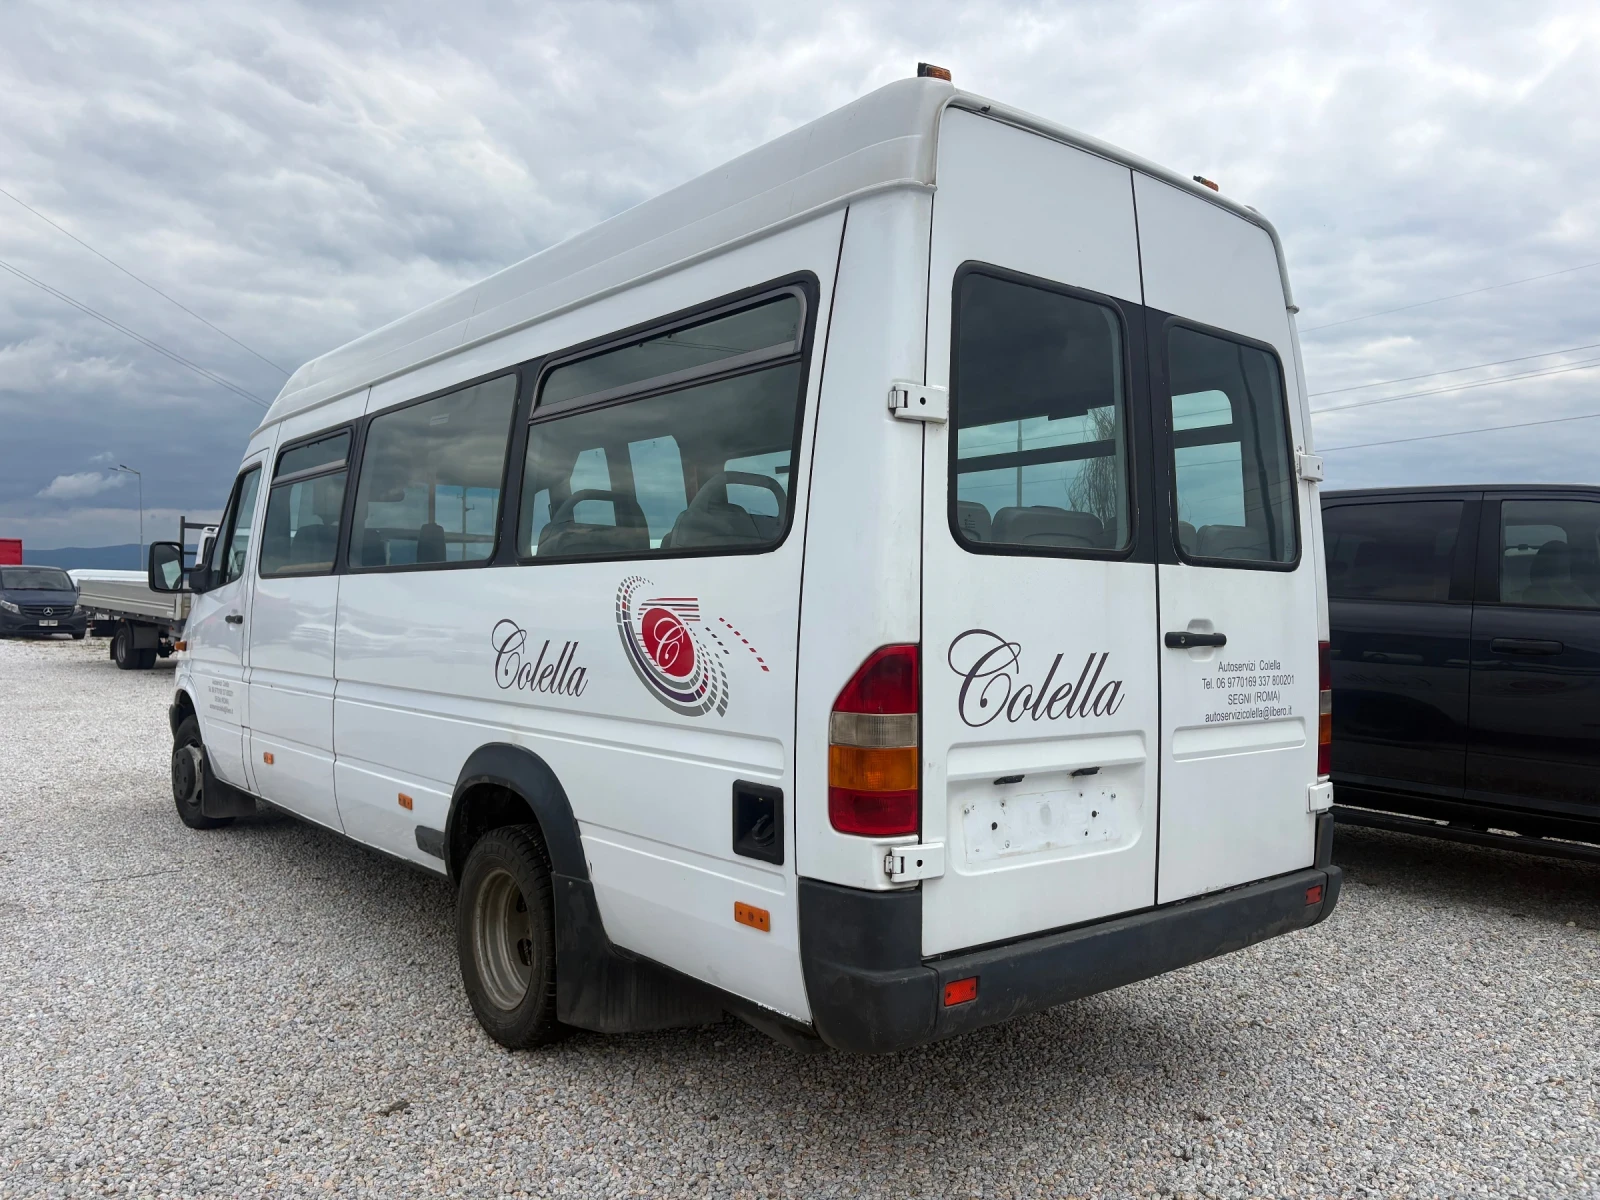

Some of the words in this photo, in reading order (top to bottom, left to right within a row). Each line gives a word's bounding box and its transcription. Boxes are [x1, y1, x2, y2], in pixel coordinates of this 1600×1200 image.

[654, 617, 685, 669] C
[491, 618, 588, 697] Colella
[1218, 661, 1256, 673] Autoservizi
[1259, 660, 1281, 671] Colella
[947, 628, 1125, 727] Colella
[1202, 678, 1215, 689] Tel.
[1216, 677, 1226, 689] 06
[1227, 676, 1257, 688] 9770169
[1258, 675, 1271, 687] 337
[1227, 693, 1252, 705] SEGNI
[1254, 690, 1281, 704] (ROMA)
[1205, 705, 1293, 722] autoservizicolella@libero.it
